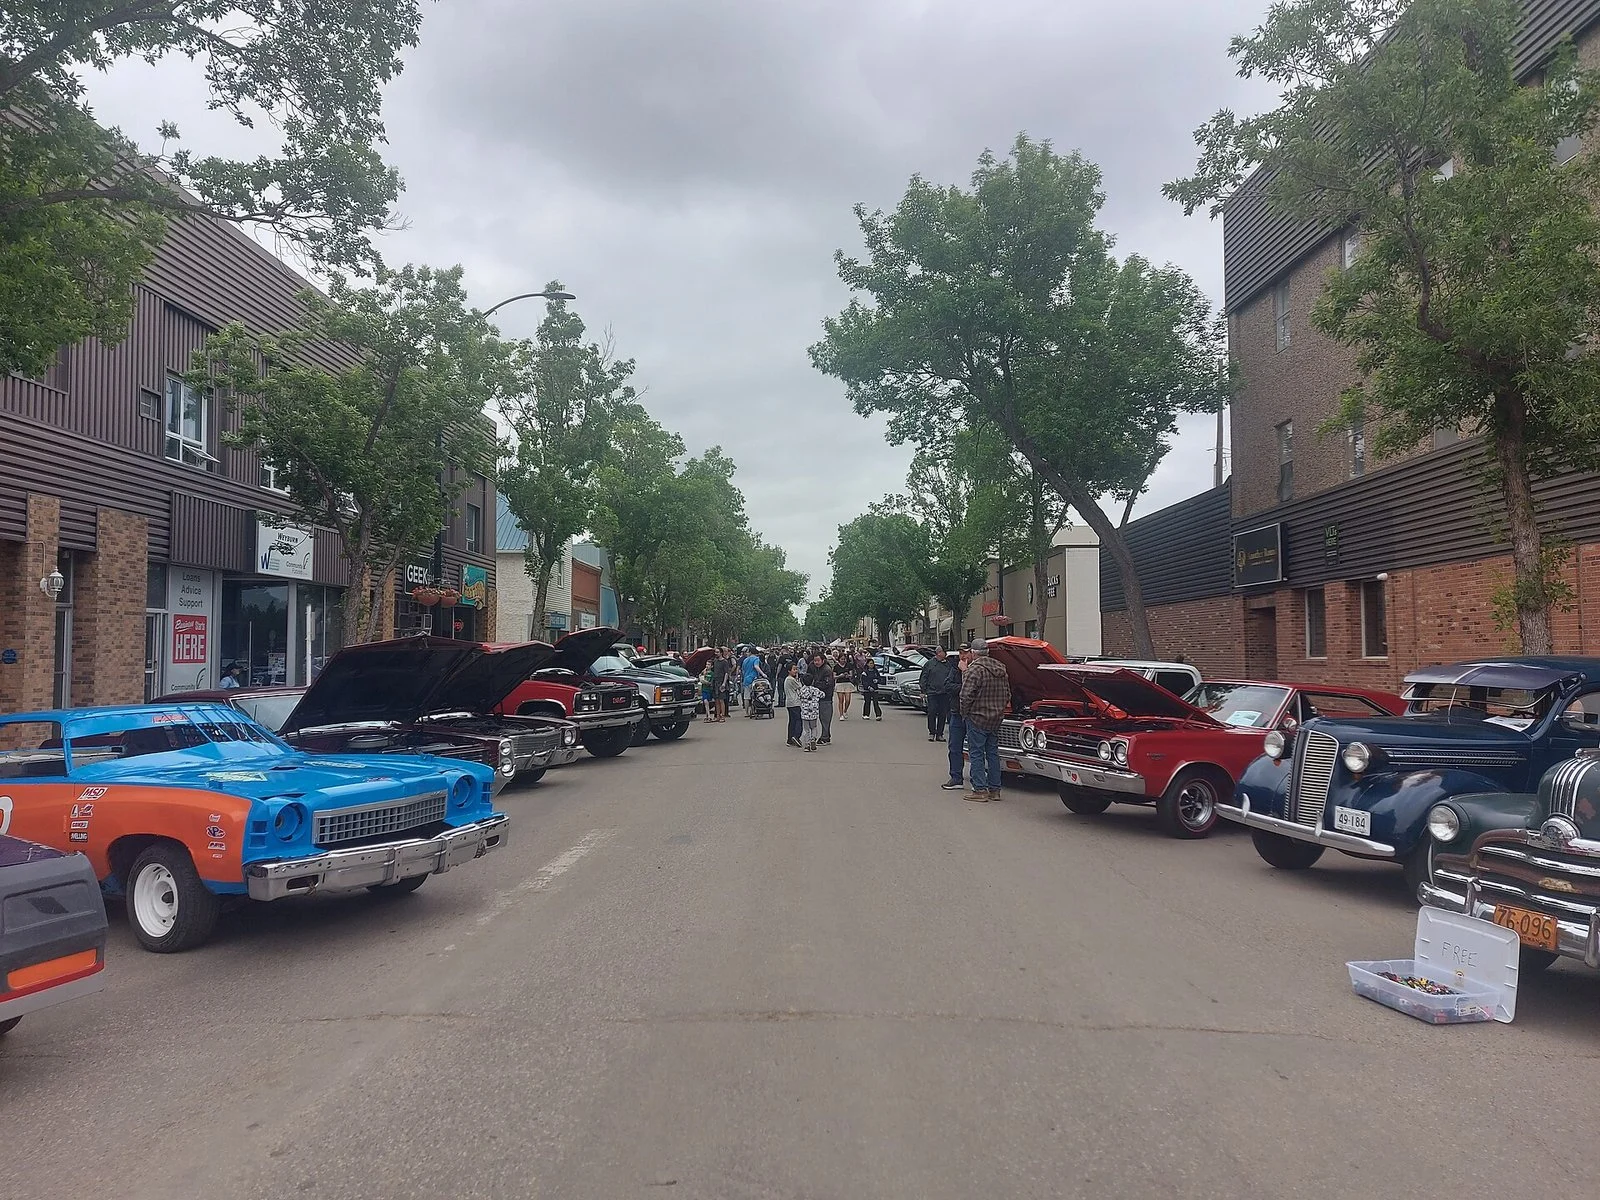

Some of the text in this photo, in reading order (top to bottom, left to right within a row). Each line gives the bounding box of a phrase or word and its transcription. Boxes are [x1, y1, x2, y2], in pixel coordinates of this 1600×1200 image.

[182, 571, 201, 582] Loans
[407, 564, 428, 584] GEEK
[180, 586, 202, 596] Advice
[178, 597, 203, 609] Support
[175, 633, 205, 660] HERE
[82, 788, 106, 797] MSD
[1441, 941, 1478, 967] FREE
